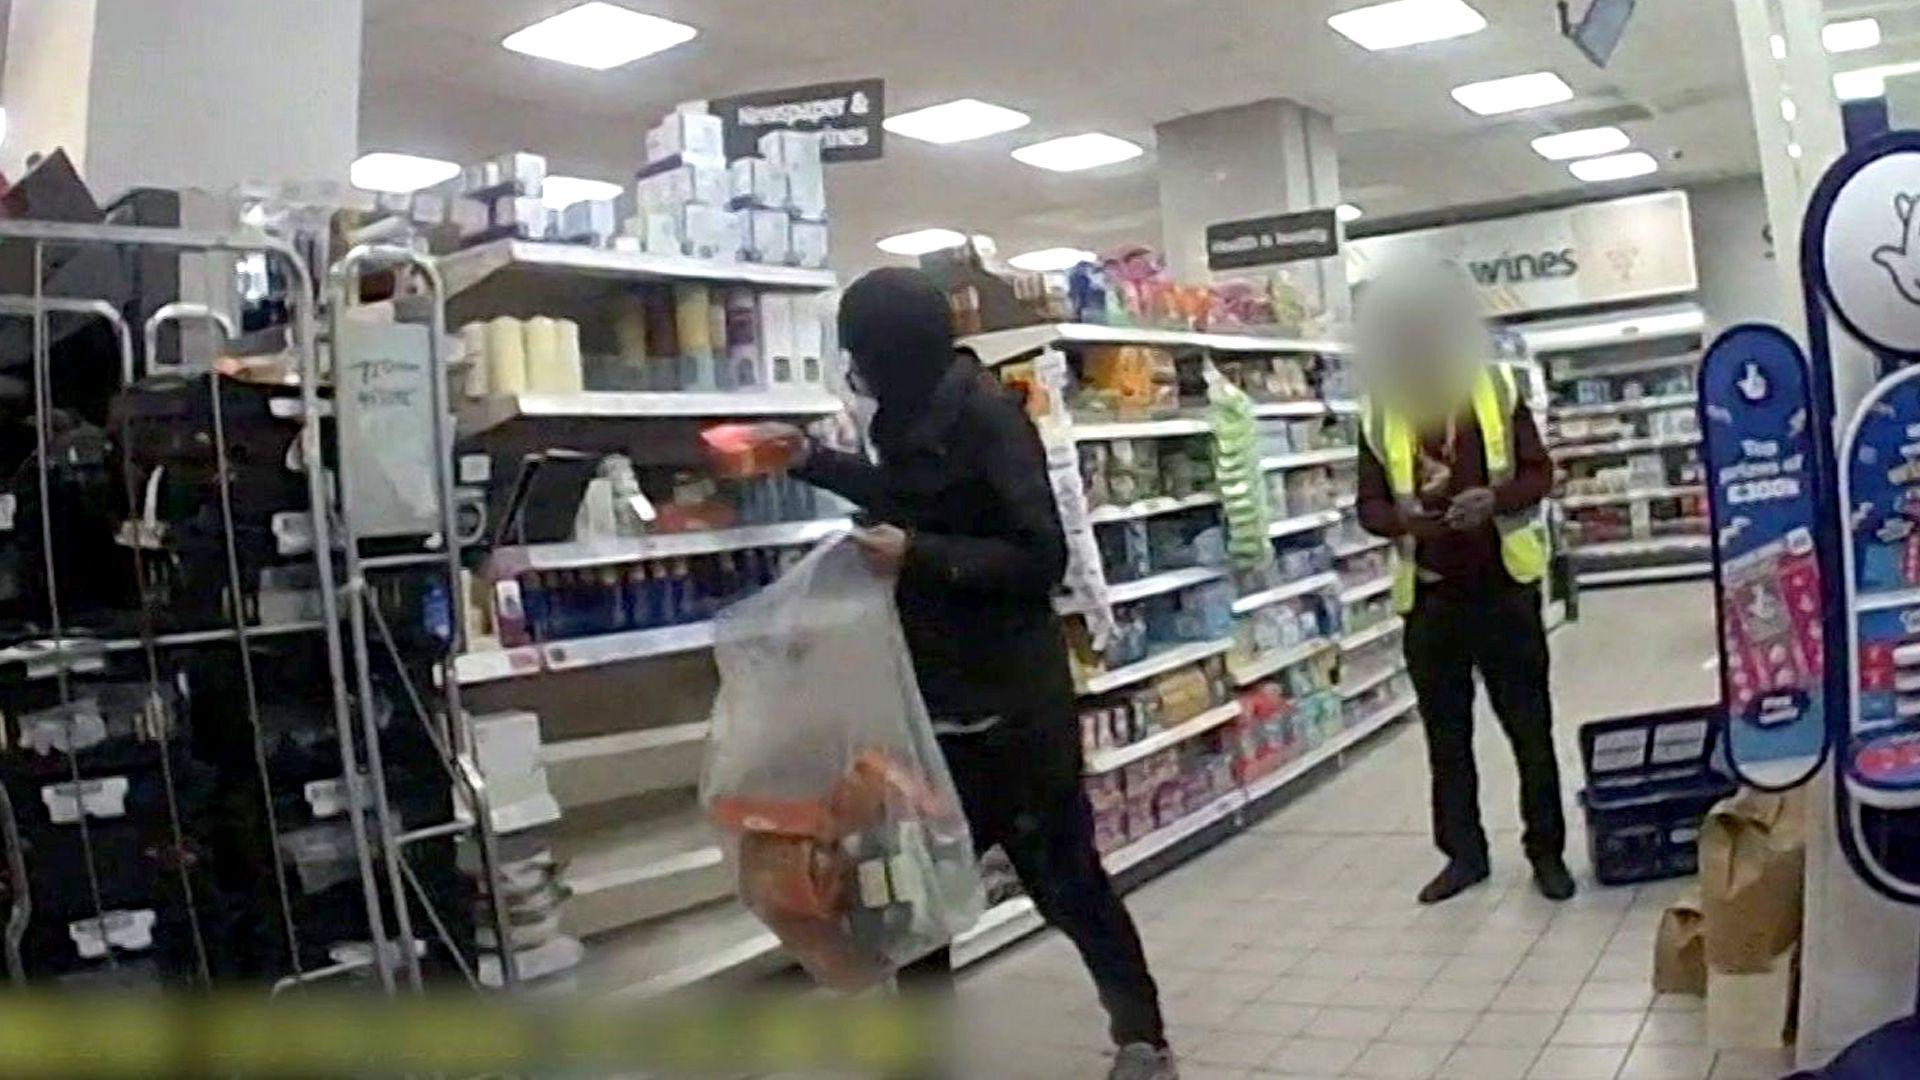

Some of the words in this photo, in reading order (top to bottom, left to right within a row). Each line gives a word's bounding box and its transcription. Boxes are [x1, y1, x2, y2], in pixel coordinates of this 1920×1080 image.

[738, 97, 848, 127] Newspaper
[851, 91, 869, 113] &
[1468, 247, 1579, 284] wines
